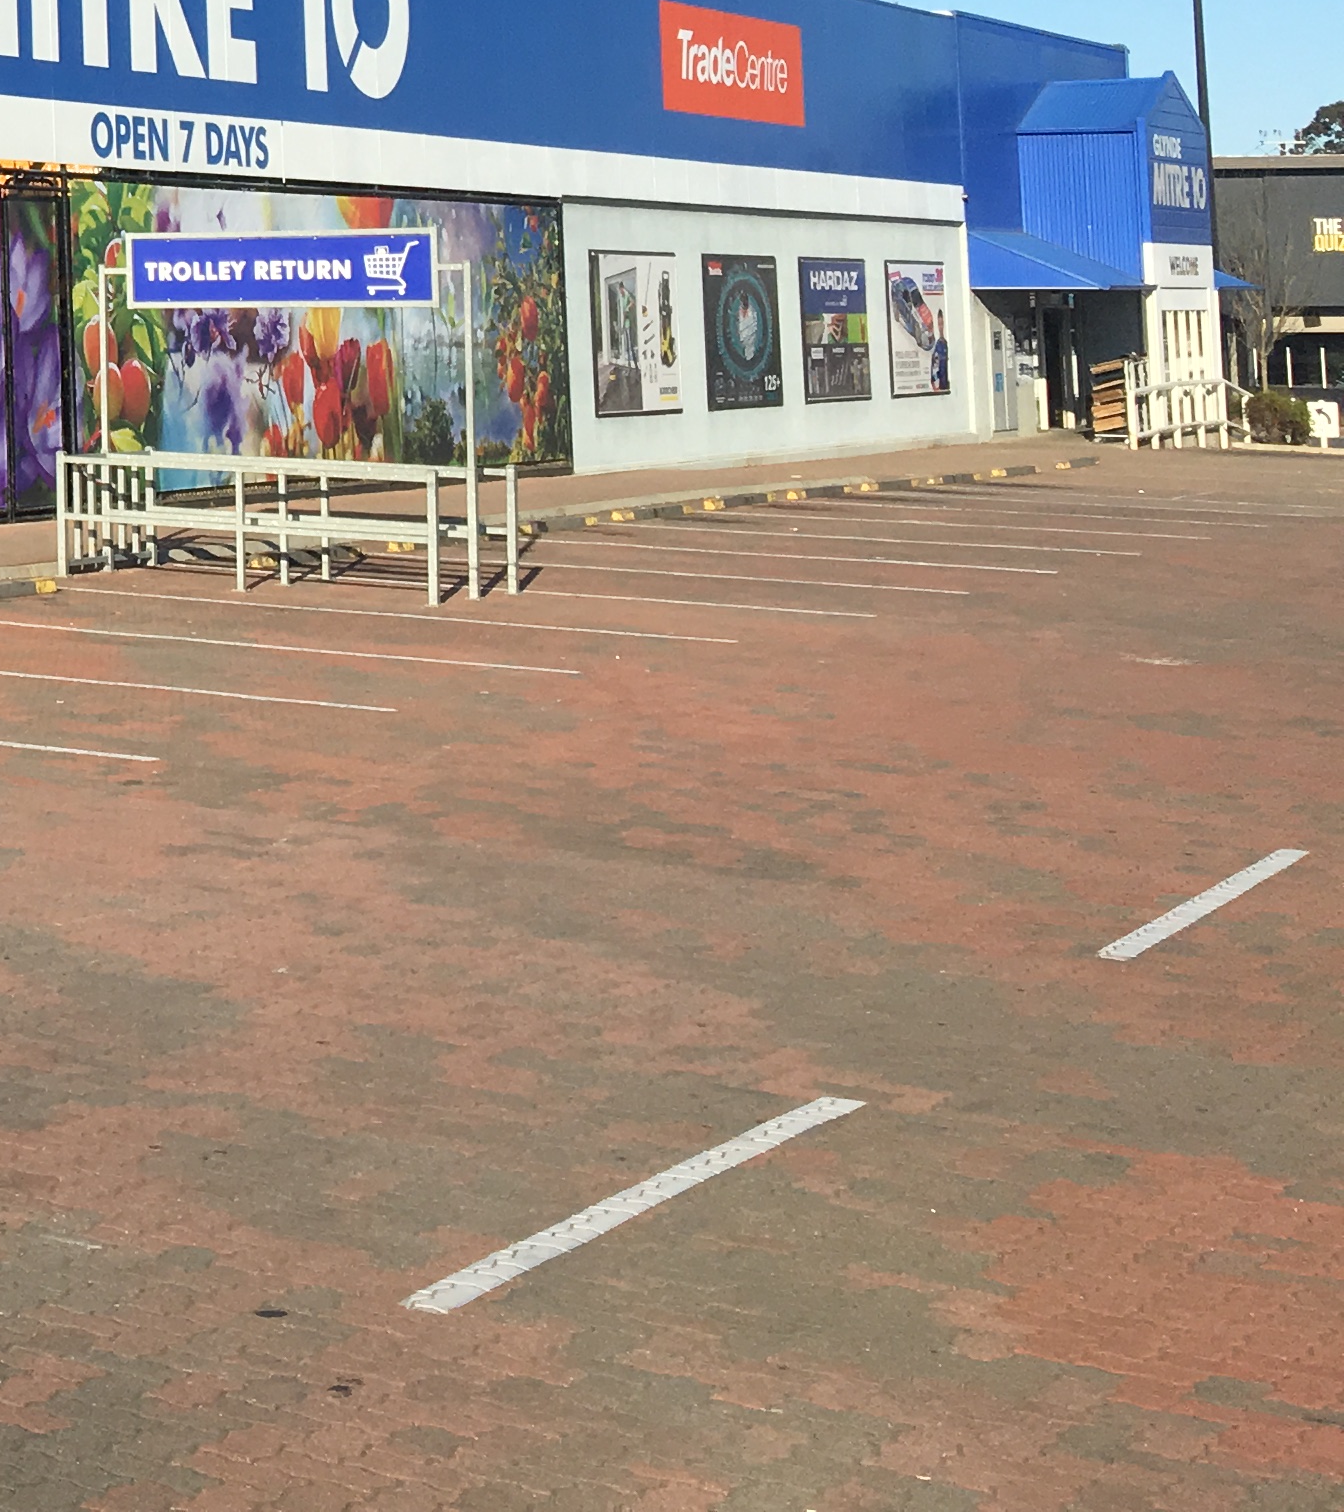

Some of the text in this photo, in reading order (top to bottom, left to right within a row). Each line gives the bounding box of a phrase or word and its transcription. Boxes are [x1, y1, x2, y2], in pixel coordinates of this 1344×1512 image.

[677, 29, 788, 94] TradeCentre
[91, 112, 269, 170] OPEN 7 DAYS
[1153, 133, 1182, 159] GLYNDE
[1153, 162, 1206, 210] MITRE 10
[1313, 218, 1343, 235] THE
[144, 259, 352, 282] TROLLEY RETURN
[809, 270, 859, 291] HARDAZ
